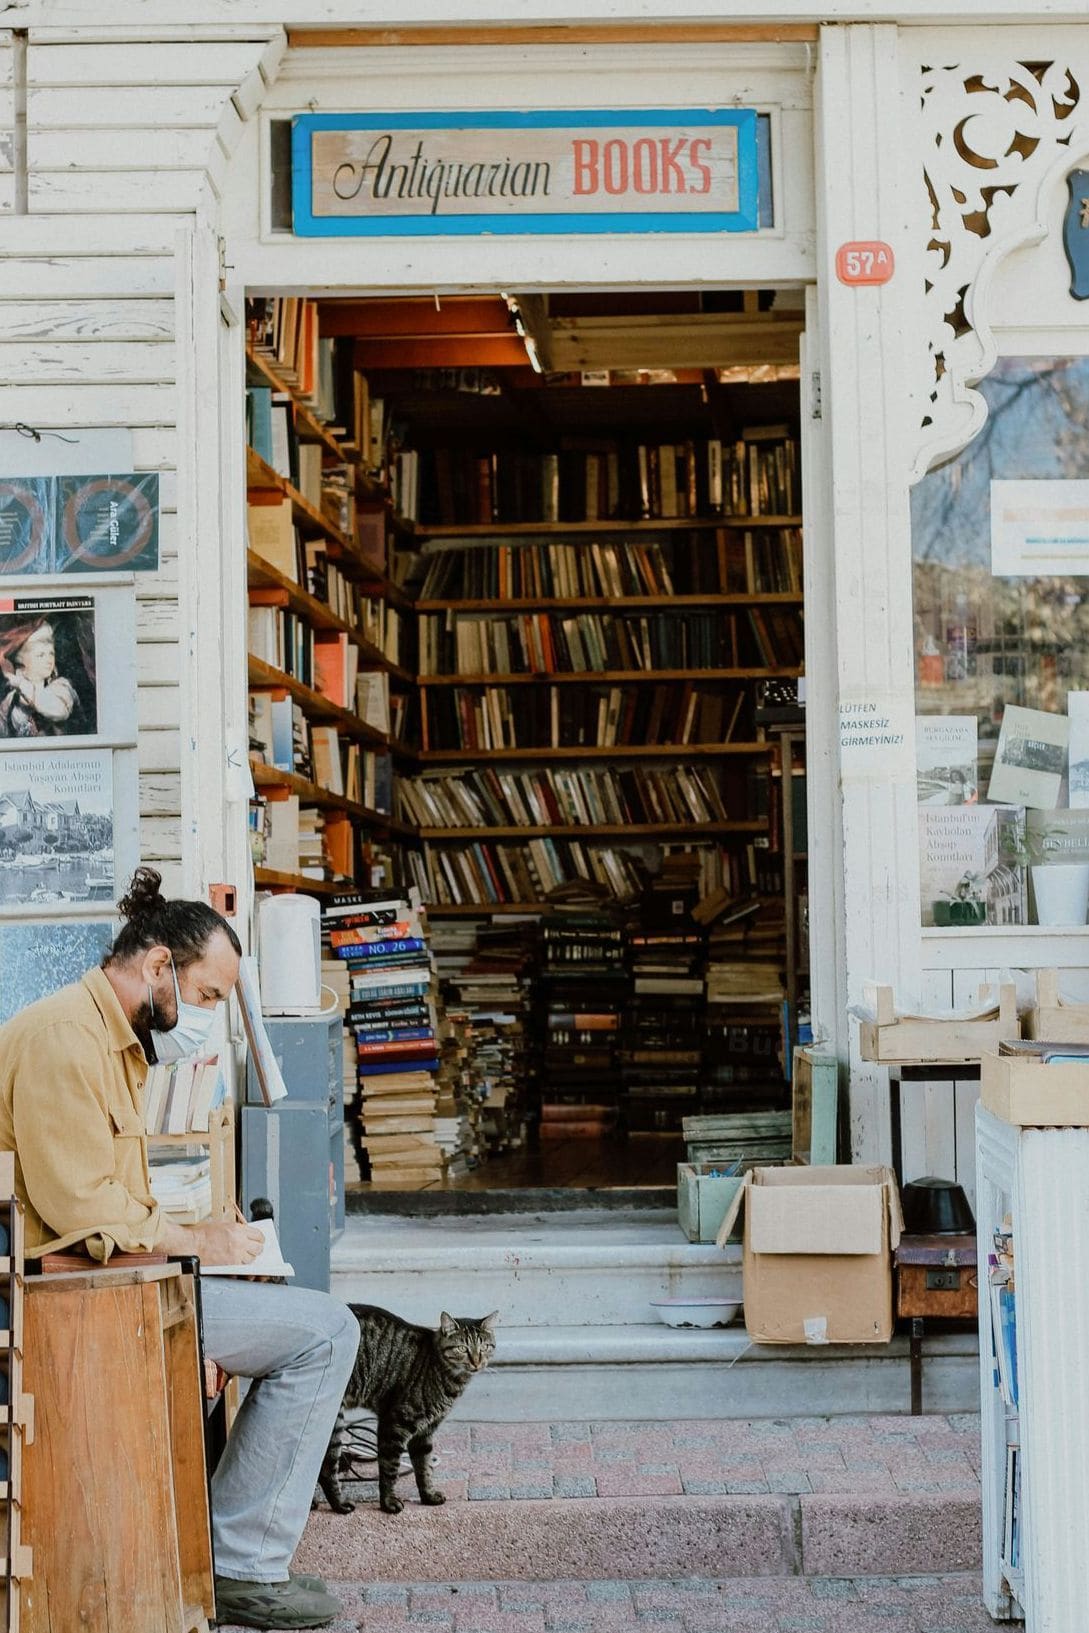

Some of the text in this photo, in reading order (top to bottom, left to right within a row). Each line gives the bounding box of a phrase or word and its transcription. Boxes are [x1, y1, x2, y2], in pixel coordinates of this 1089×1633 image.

[332, 134, 713, 216] Antiquarian BOOKS
[840, 717, 890, 731] MASKESİZ
[841, 734, 904, 747] GİRMEYİNİZ!
[333, 895, 362, 904] MASKE
[368, 941, 406, 955] NO. 26
